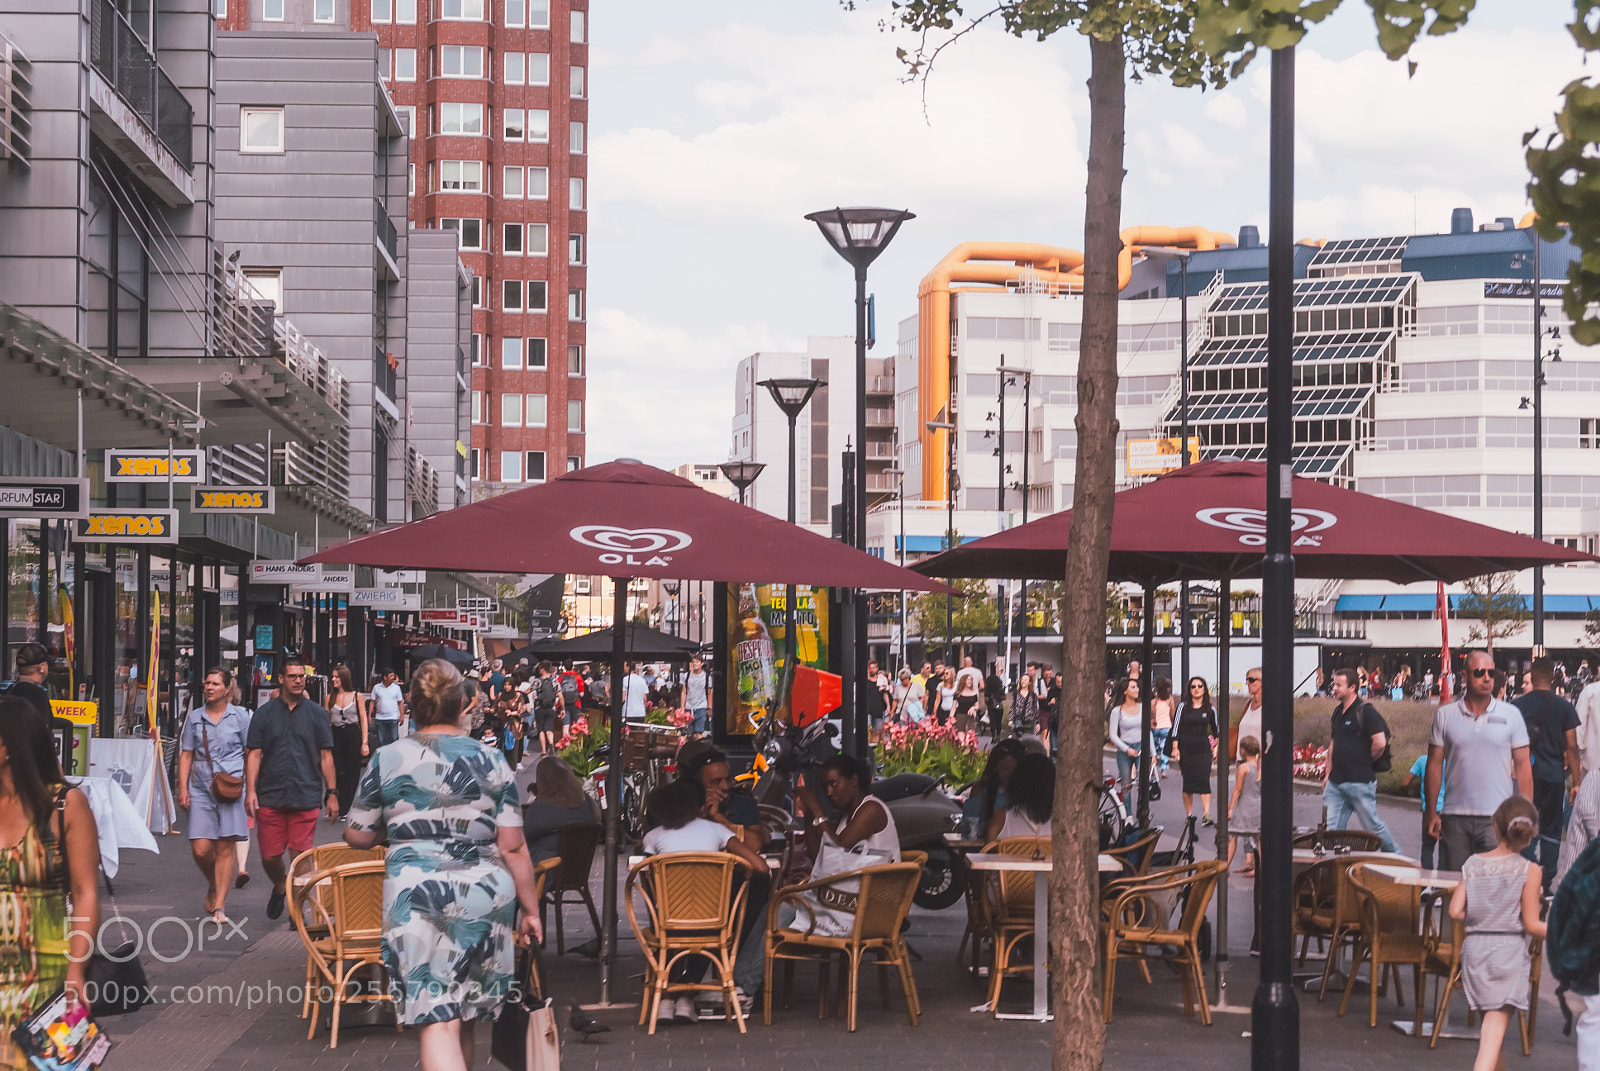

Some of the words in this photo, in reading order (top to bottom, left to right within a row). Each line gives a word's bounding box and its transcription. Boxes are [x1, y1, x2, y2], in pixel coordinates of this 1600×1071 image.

[117, 457, 192, 476] xenos
[200, 492, 263, 507] xenos
[86, 515, 164, 535] xenos
[1238, 534, 1321, 547] OA
[598, 553, 669, 567] OLA
[265, 565, 286, 573] HANS
[287, 565, 315, 573] ANDERS
[323, 575, 349, 583] ANDERS
[355, 590, 397, 601] ZWIERIG
[770, 610, 814, 627] MOITO
[55, 706, 87, 716] WEEK
